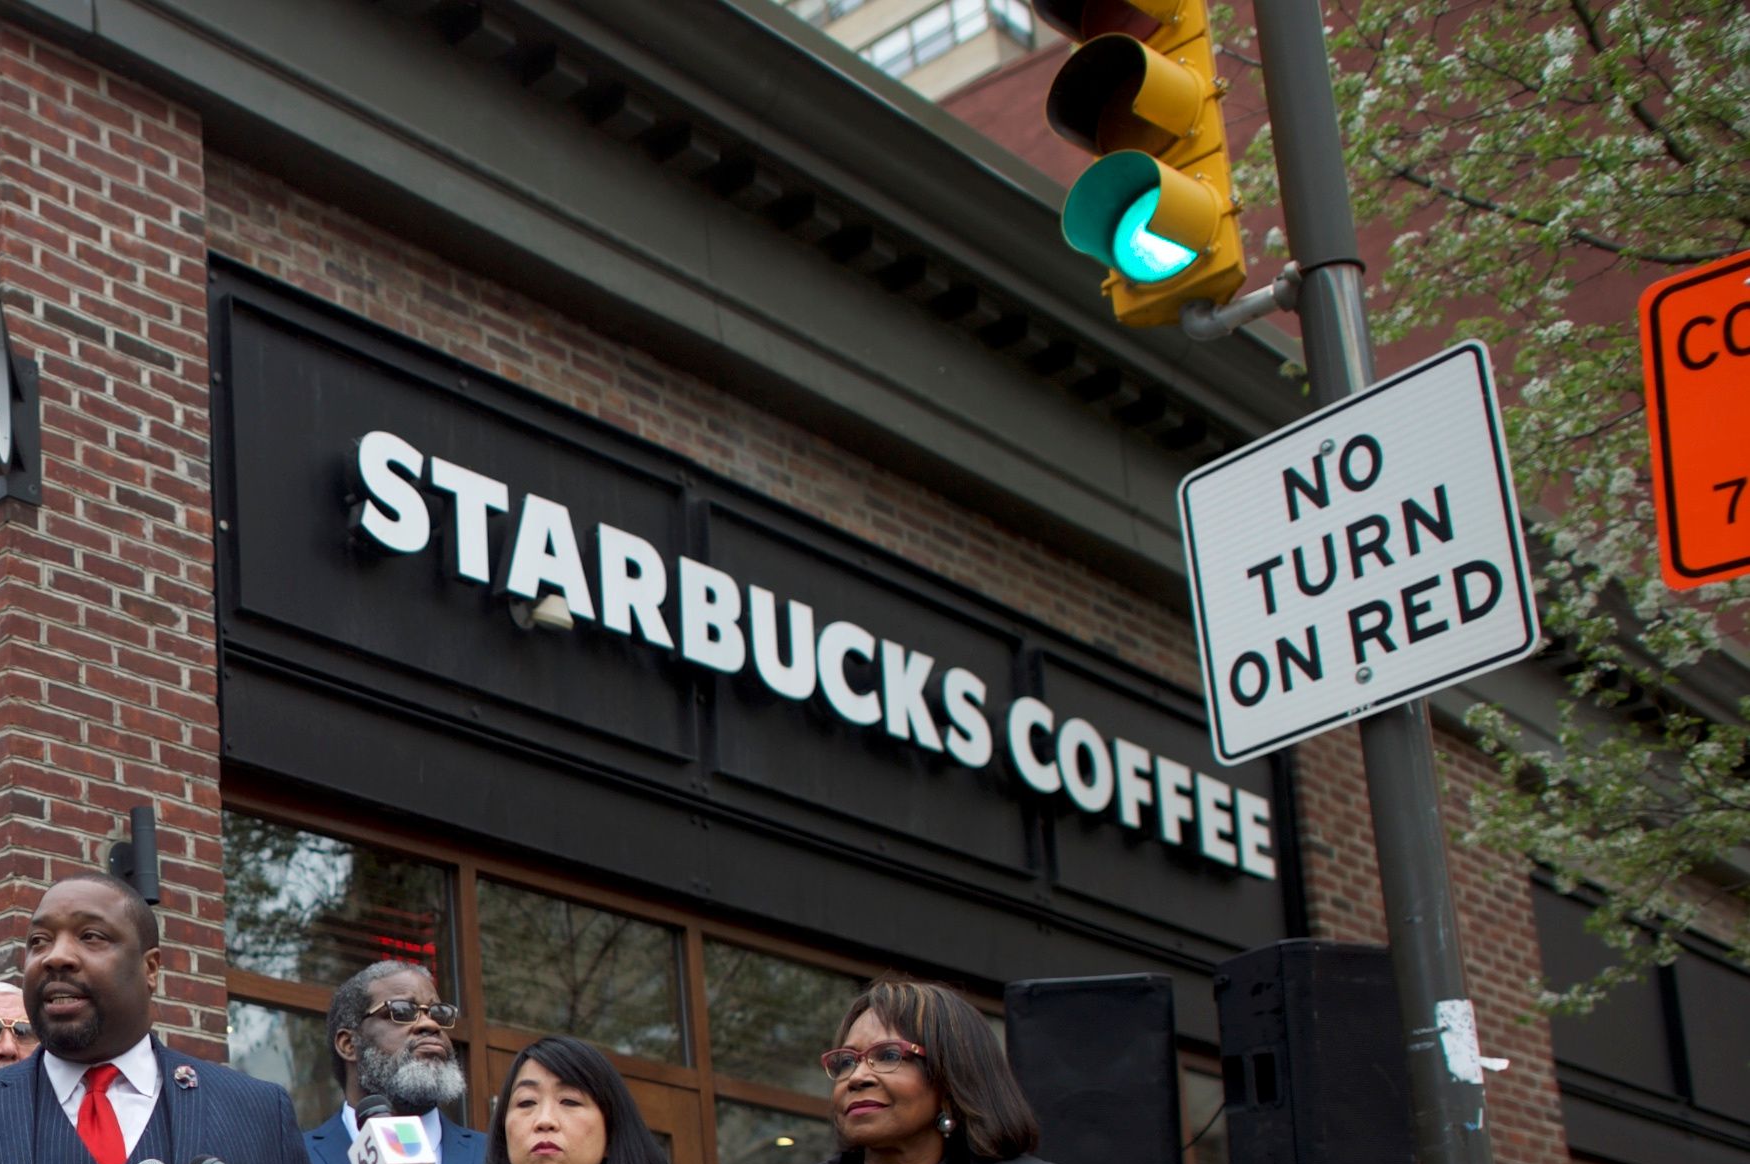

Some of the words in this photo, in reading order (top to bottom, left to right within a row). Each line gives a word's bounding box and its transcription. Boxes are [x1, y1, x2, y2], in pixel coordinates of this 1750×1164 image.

[1282, 433, 1383, 522] NO
[1246, 484, 1454, 616] TURN
[359, 432, 992, 767] STARBUCKS
[1009, 697, 1276, 879] COFFEE
[1229, 625, 1322, 708] ON
[1347, 560, 1503, 667] RED
